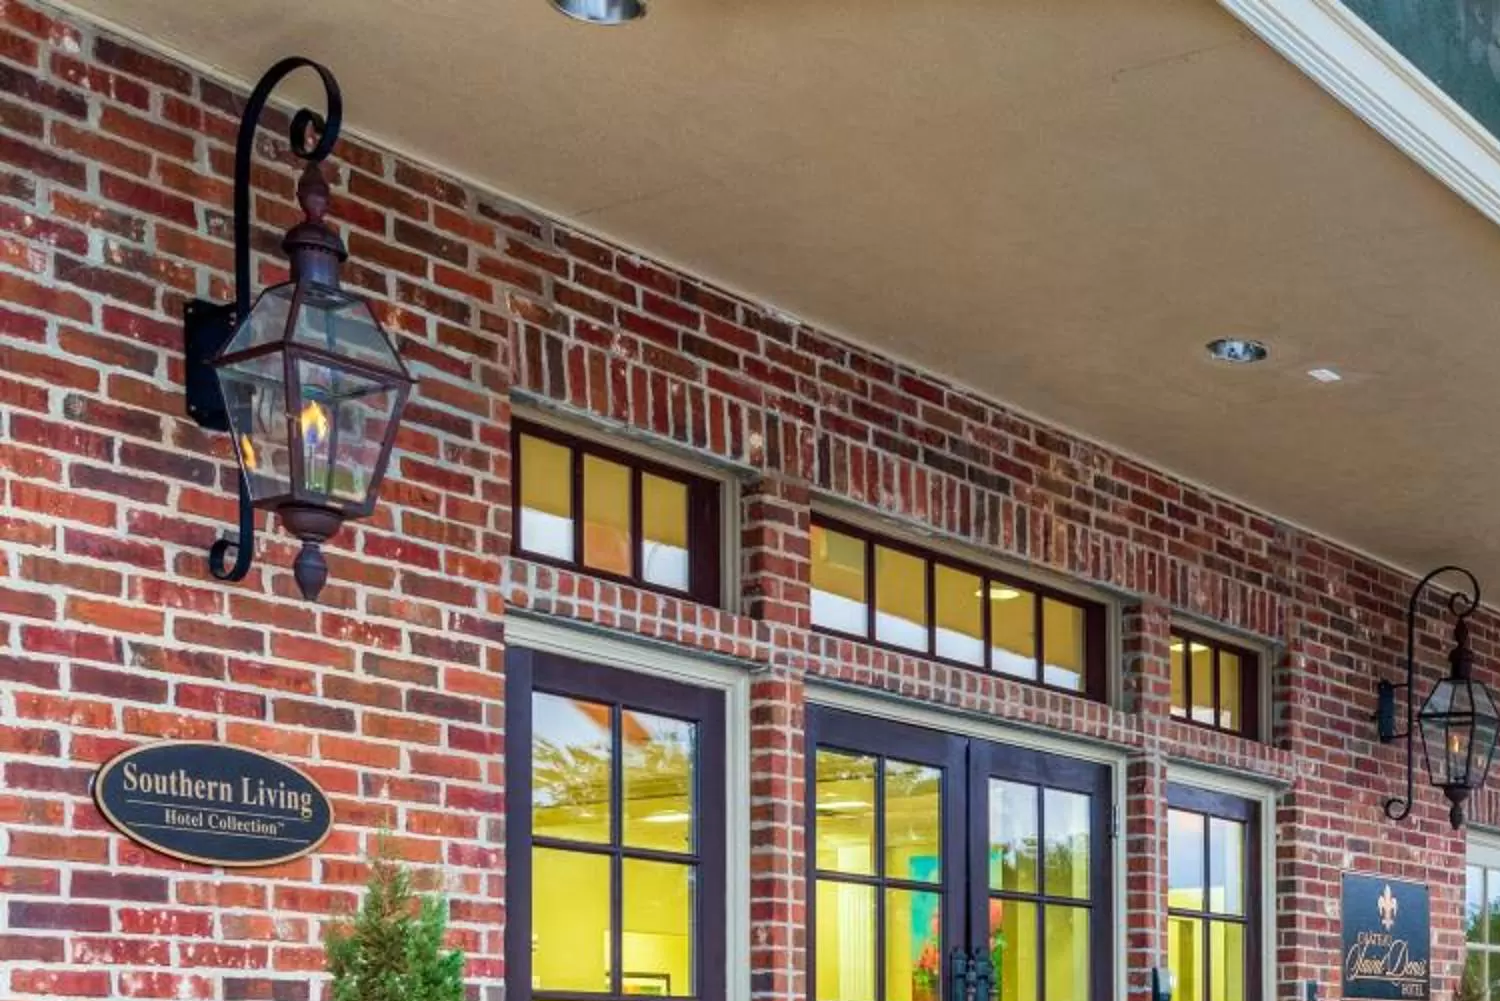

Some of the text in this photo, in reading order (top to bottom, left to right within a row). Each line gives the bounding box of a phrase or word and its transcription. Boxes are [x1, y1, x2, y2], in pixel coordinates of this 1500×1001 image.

[122, 762, 313, 819] Southern Living
[165, 808, 204, 828] Hotel
